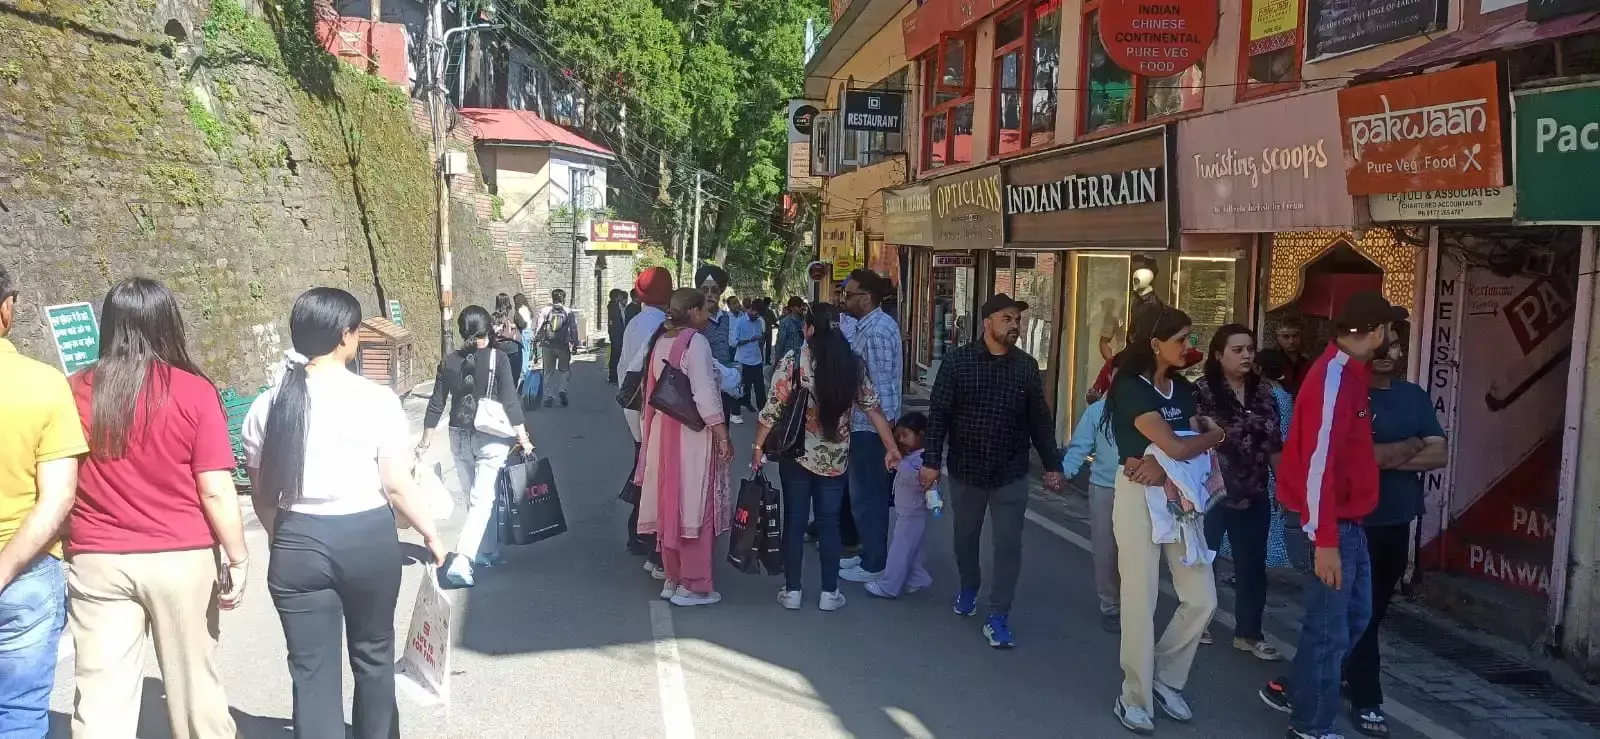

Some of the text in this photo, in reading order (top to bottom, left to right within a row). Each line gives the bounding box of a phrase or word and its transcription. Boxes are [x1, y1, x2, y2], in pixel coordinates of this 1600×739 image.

[1139, 4, 1180, 15] INDIAN
[1132, 19, 1186, 29] CHINESE
[1115, 32, 1201, 43] CONTINENTAL
[1126, 47, 1189, 58] PURE VEG
[1140, 61, 1175, 72] FOOD
[848, 112, 899, 128] RESTAURANT
[1347, 94, 1487, 159] pakwaan
[1536, 117, 1599, 153] Pac
[1193, 147, 1260, 187] Twisting
[1367, 160, 1394, 174] Pure
[1425, 154, 1457, 171] Food
[937, 174, 1001, 219] OPTICIANS
[1007, 167, 1157, 215] INDIAN TERRAIN
[1425, 191, 1432, 199] &
[1434, 187, 1500, 199] ASSOCIATES
[1401, 200, 1482, 209] CHARTERED ACCOUNTANTS
[412, 637, 423, 653] FOR
